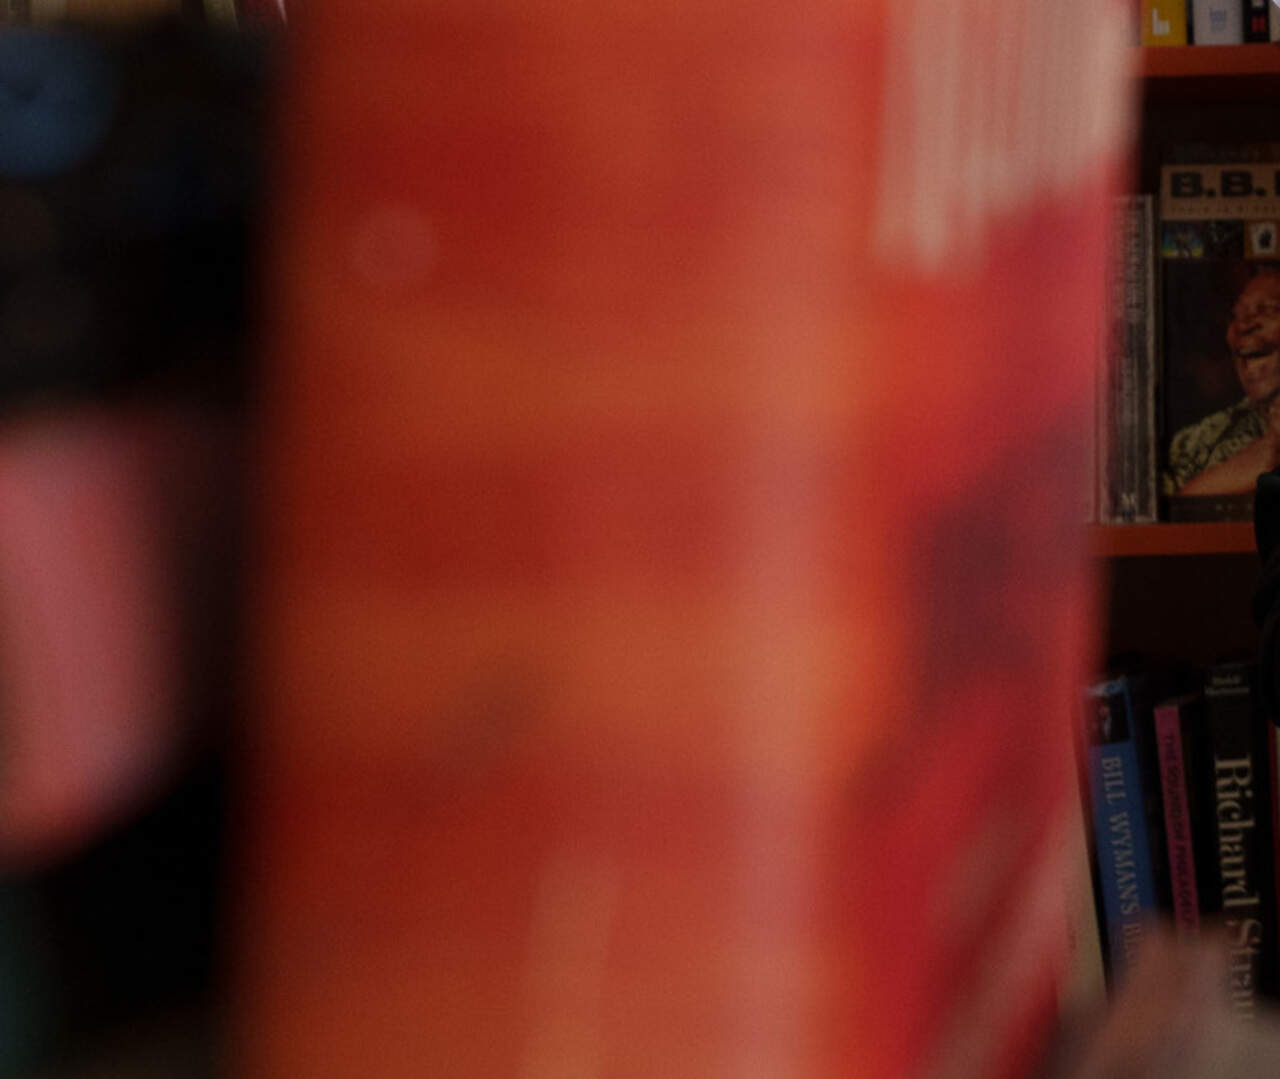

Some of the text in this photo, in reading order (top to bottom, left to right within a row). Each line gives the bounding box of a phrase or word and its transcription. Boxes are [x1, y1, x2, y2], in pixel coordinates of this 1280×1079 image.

[1171, 169, 1267, 198] B.B.
[1101, 754, 1142, 916] BILL WYMAN'S
[1213, 753, 1263, 1020] Richard Strau
